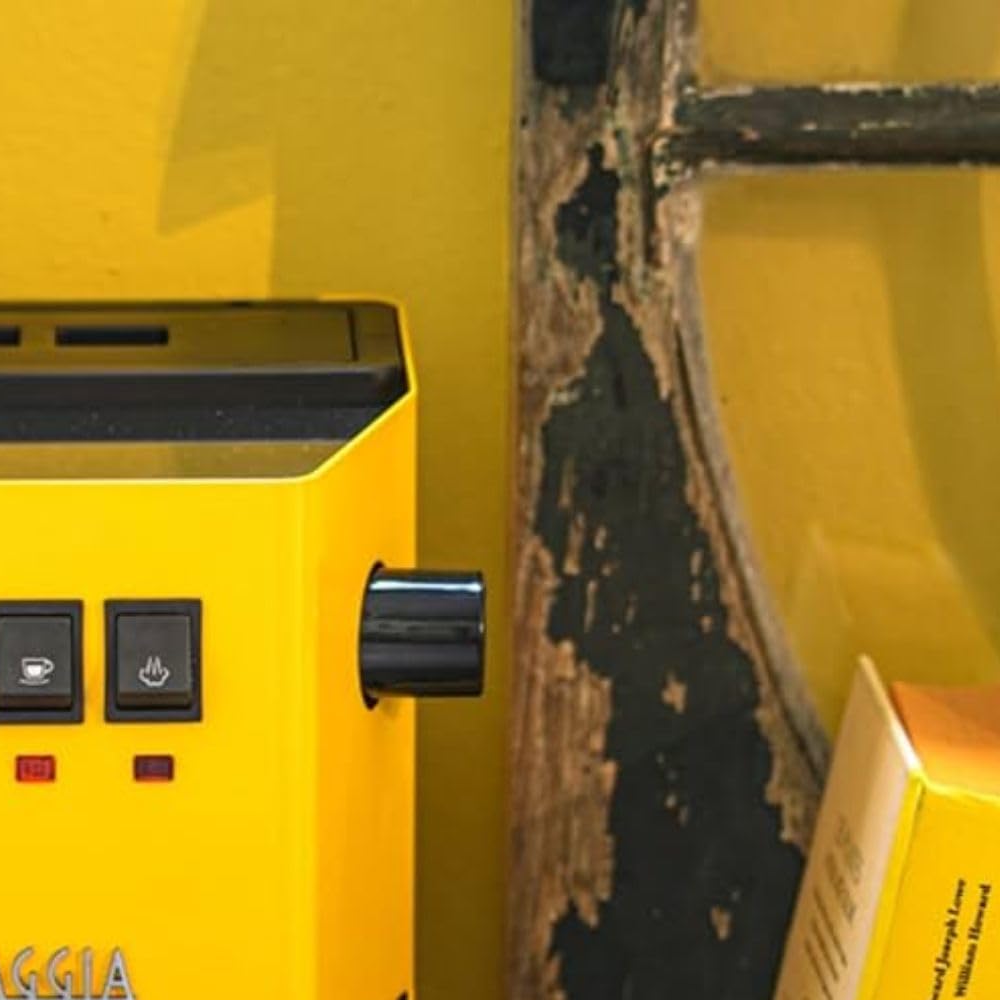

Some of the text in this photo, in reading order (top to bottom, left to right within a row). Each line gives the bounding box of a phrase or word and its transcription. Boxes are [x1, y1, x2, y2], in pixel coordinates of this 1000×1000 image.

[935, 919, 957, 968] Joseph
[954, 884, 991, 997] William Howard
